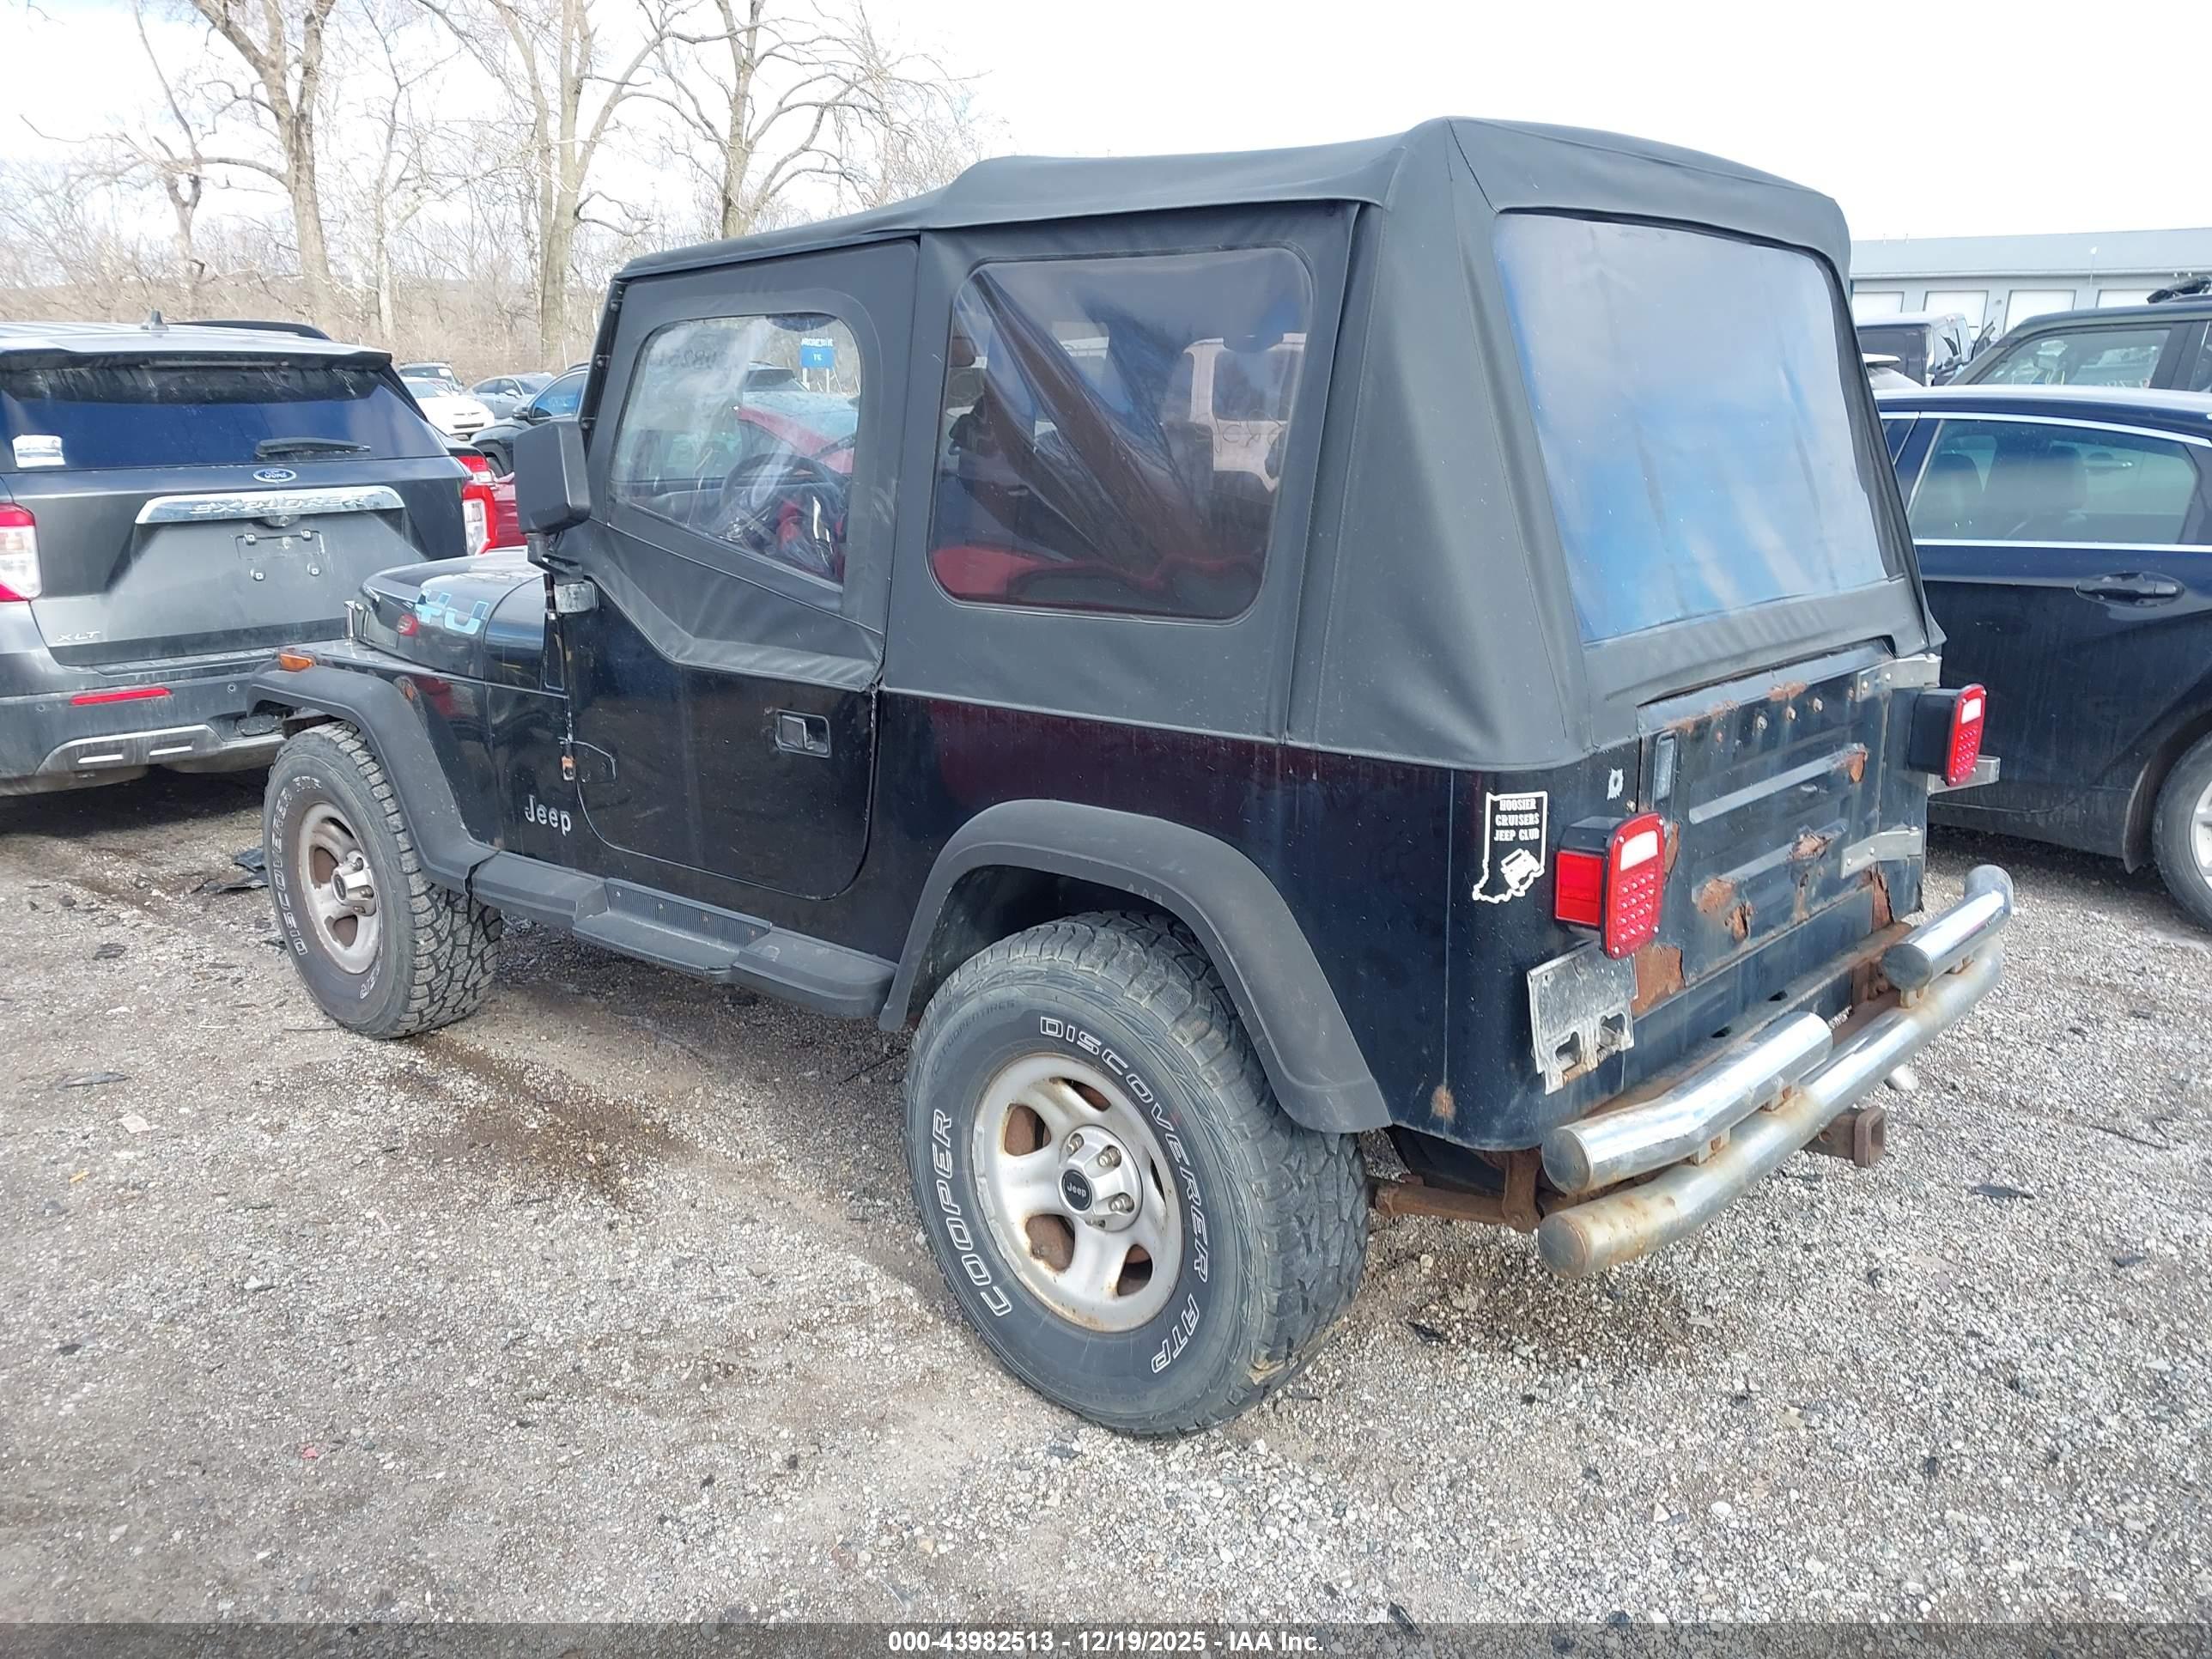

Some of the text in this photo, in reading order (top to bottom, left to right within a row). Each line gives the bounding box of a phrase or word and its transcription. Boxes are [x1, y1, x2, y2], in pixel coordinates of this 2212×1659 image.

[57, 630, 100, 642] XLT
[1499, 799, 1536, 811] HOOSIER
[524, 793, 572, 837] Jeep
[1495, 812, 1540, 826] CRUISERS
[1494, 828, 1540, 842] JEEP CLUB
[933, 1016, 1208, 1374] COOPER DISCOVERER ATP
[1066, 1182, 1087, 1198] Jeep
